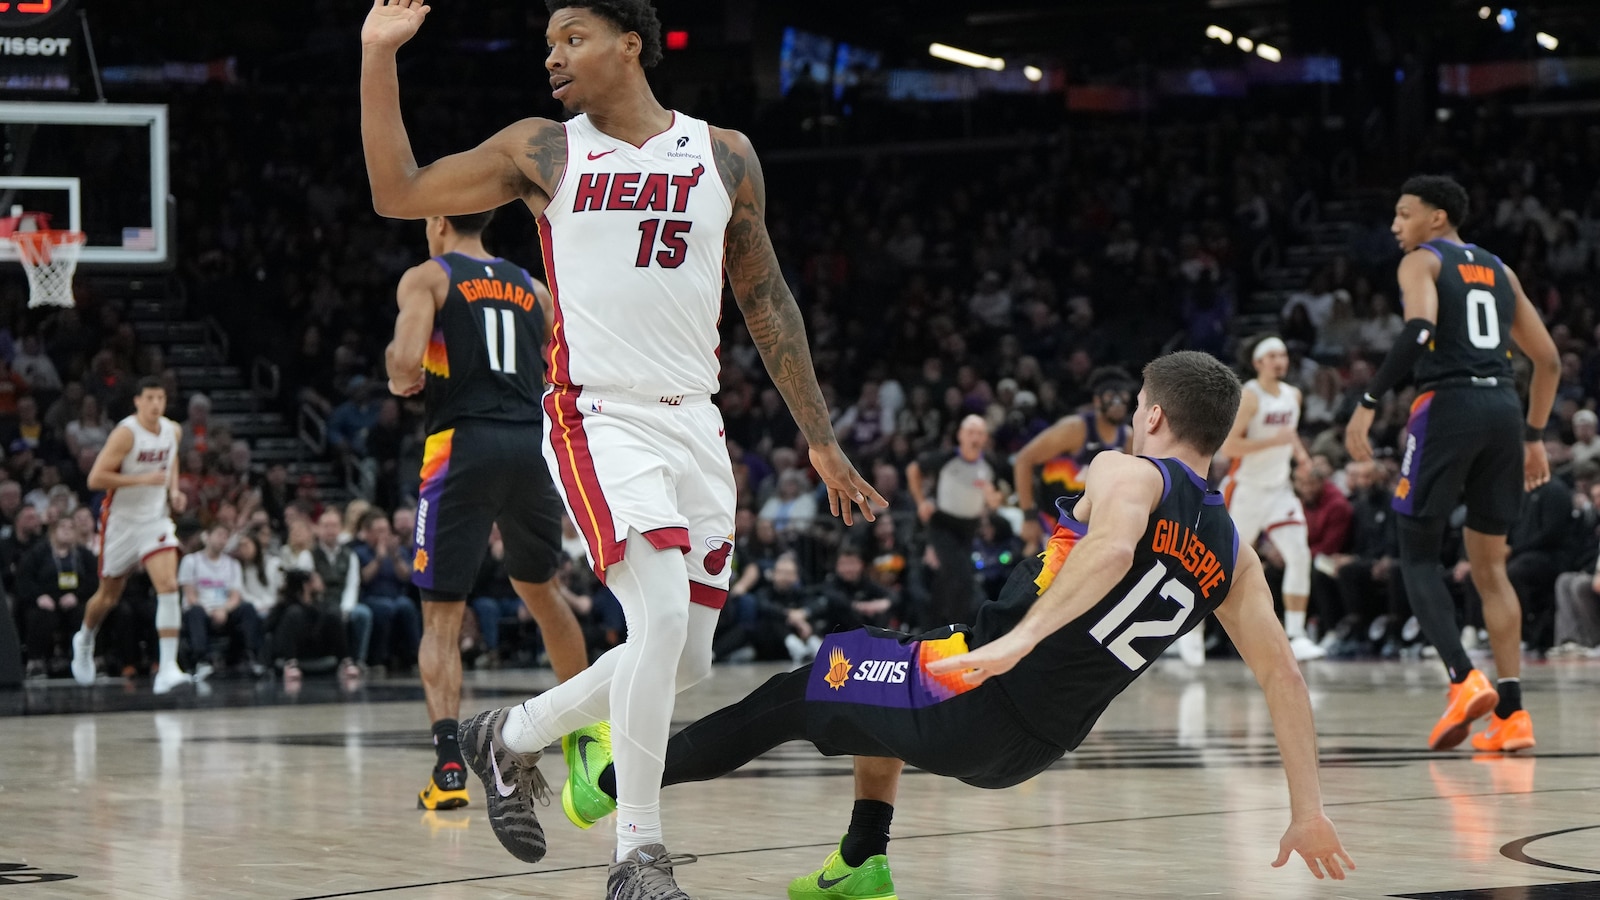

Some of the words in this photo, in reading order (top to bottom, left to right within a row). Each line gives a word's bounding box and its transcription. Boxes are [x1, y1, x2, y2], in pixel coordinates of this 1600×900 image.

[667, 151, 701, 160] Robinhood
[573, 162, 705, 213] HEAT
[635, 218, 692, 268] 15
[457, 278, 535, 312] IGHODARO
[1466, 288, 1500, 349] 0
[483, 307, 517, 374] 11
[416, 498, 429, 546] SUNS
[1152, 519, 1226, 599] GILLESPIE
[1089, 559, 1195, 671] 12
[853, 660, 909, 684] SUNS
